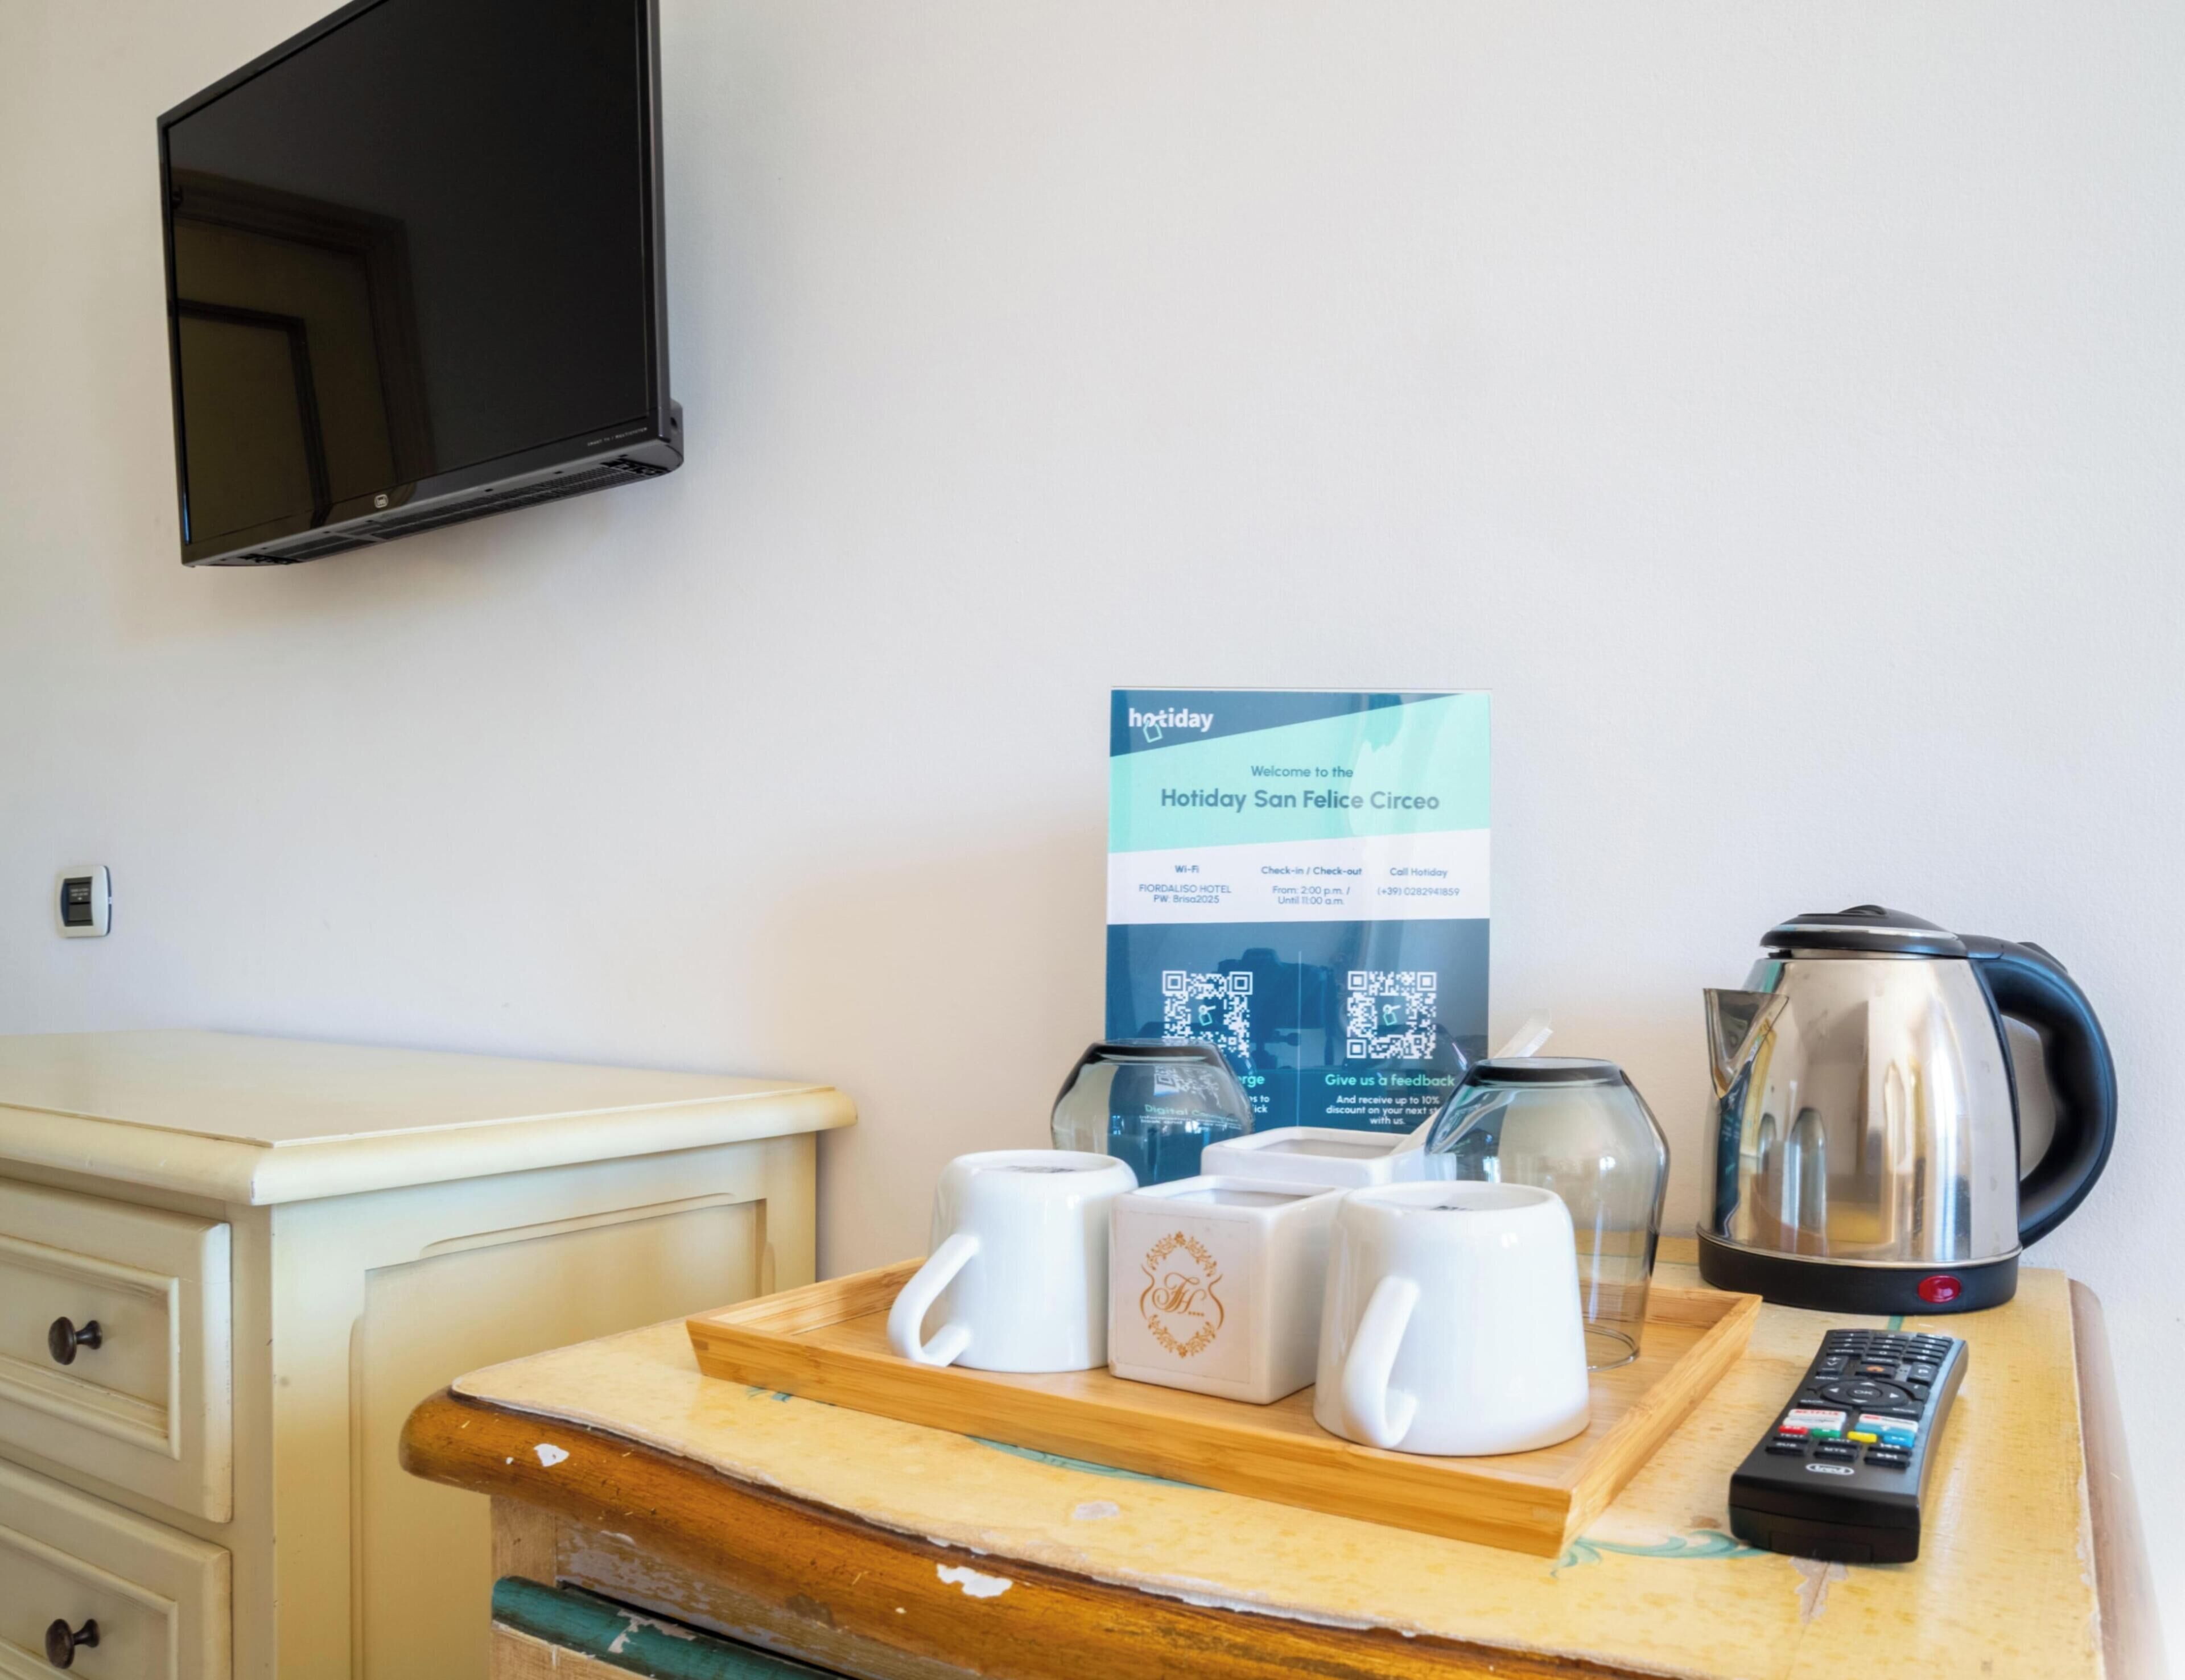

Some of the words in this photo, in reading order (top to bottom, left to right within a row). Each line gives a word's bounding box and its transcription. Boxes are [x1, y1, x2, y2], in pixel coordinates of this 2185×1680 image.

[1129, 707, 1214, 733] hotiday
[1251, 766, 1311, 777] Welcome
[1316, 767, 1329, 777] to
[1333, 766, 1353, 778] the
[1161, 788, 1247, 814] Hotiday
[1255, 790, 1297, 808] San
[1303, 790, 1364, 809] Felice
[1370, 791, 1440, 810] Circeo
[1175, 865, 1199, 873] Wi-Fi
[1313, 867, 1363, 876] Check-out
[1390, 868, 1409, 876] Call
[1411, 868, 1448, 878] Hotiday
[1139, 884, 1198, 893] FIORDALISO
[1199, 885, 1232, 894] HOTEL
[1272, 886, 1298, 894] From:
[1324, 888, 1343, 897] p.m.
[1377, 887, 1402, 896] (+39)
[1153, 894, 1170, 903] PW:
[1173, 895, 1220, 903] Brisa2025
[1325, 1074, 1357, 1085] Give
[1360, 1076, 1375, 1085] us
[1379, 1076, 1387, 1086] a
[1391, 1074, 1455, 1087] feedback
[1336, 1095, 1357, 1104] And
[1359, 1096, 1392, 1104] receive
[1395, 1097, 1407, 1107] up
[1409, 1096, 1419, 1105] to
[1422, 1096, 1440, 1105] 10%
[1326, 1105, 1366, 1115] discount
[1383, 1107, 1402, 1117] your
[1370, 1116, 1391, 1124] with
